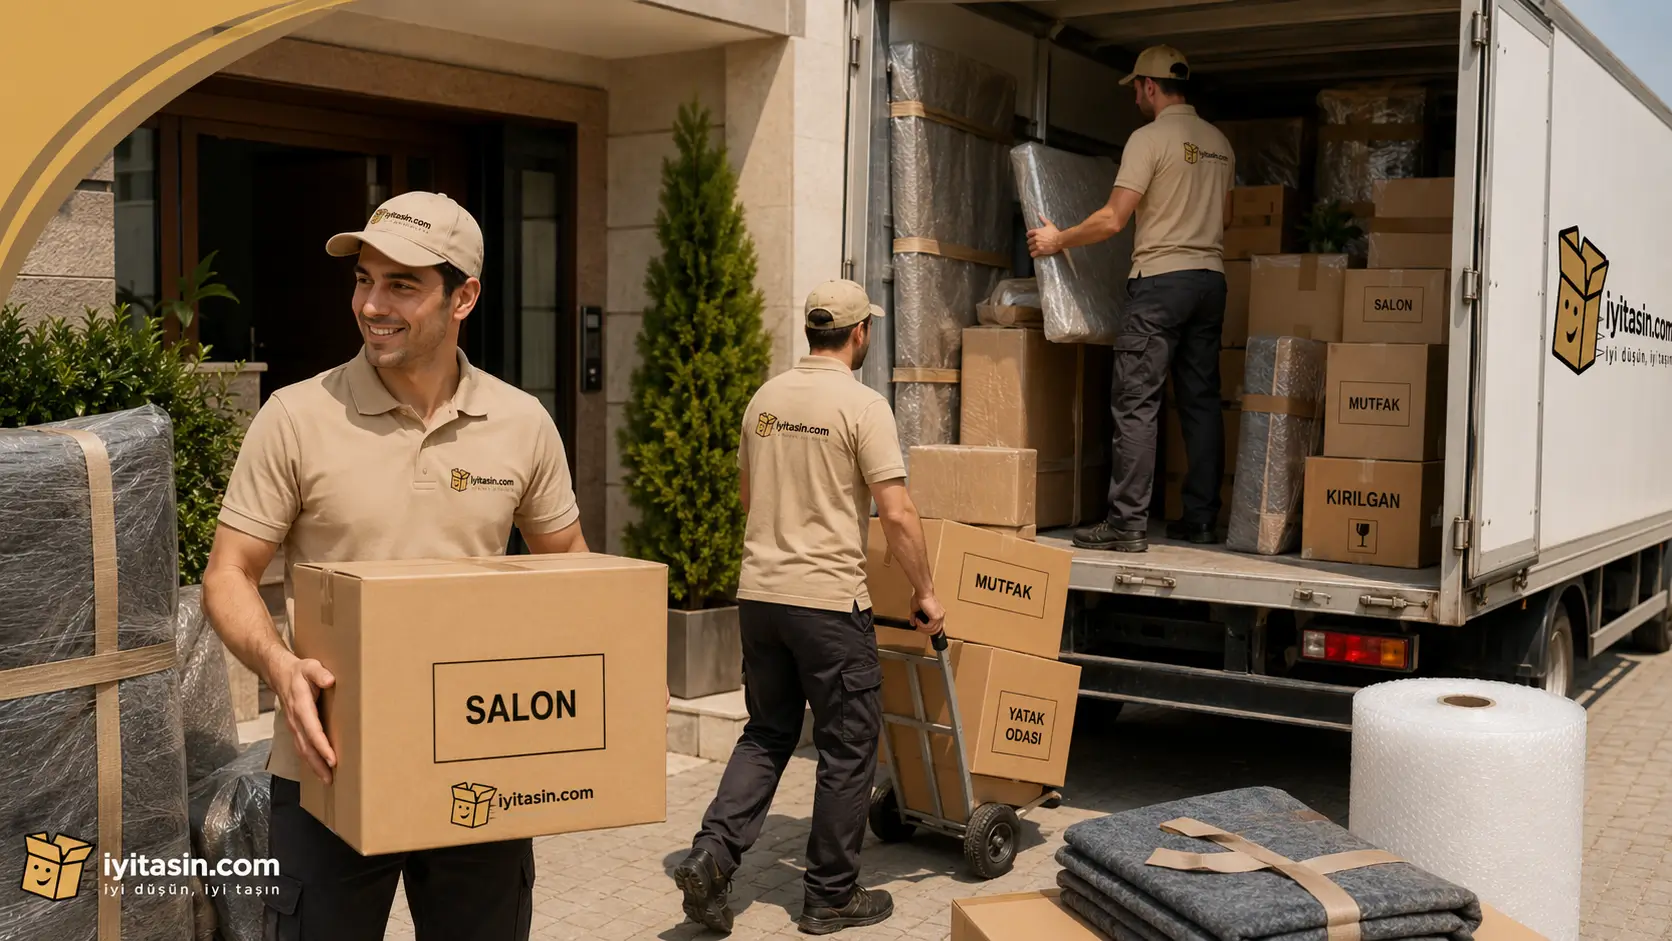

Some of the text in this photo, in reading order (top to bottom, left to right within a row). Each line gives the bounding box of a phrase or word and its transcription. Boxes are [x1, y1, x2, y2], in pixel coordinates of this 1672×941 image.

[1374, 299, 1413, 311] SALON
[1606, 290, 1672, 342] iyitasin.com
[1605, 346, 1618, 365] iyi
[1349, 397, 1400, 411] MUTFAK
[1326, 489, 1400, 509] KIRILGAN
[975, 573, 1033, 601] MUTFAK
[465, 689, 576, 725] SALON
[1009, 706, 1045, 726] YATAK
[1005, 727, 1042, 745] ODASI
[498, 788, 594, 811] iyitasin.com
